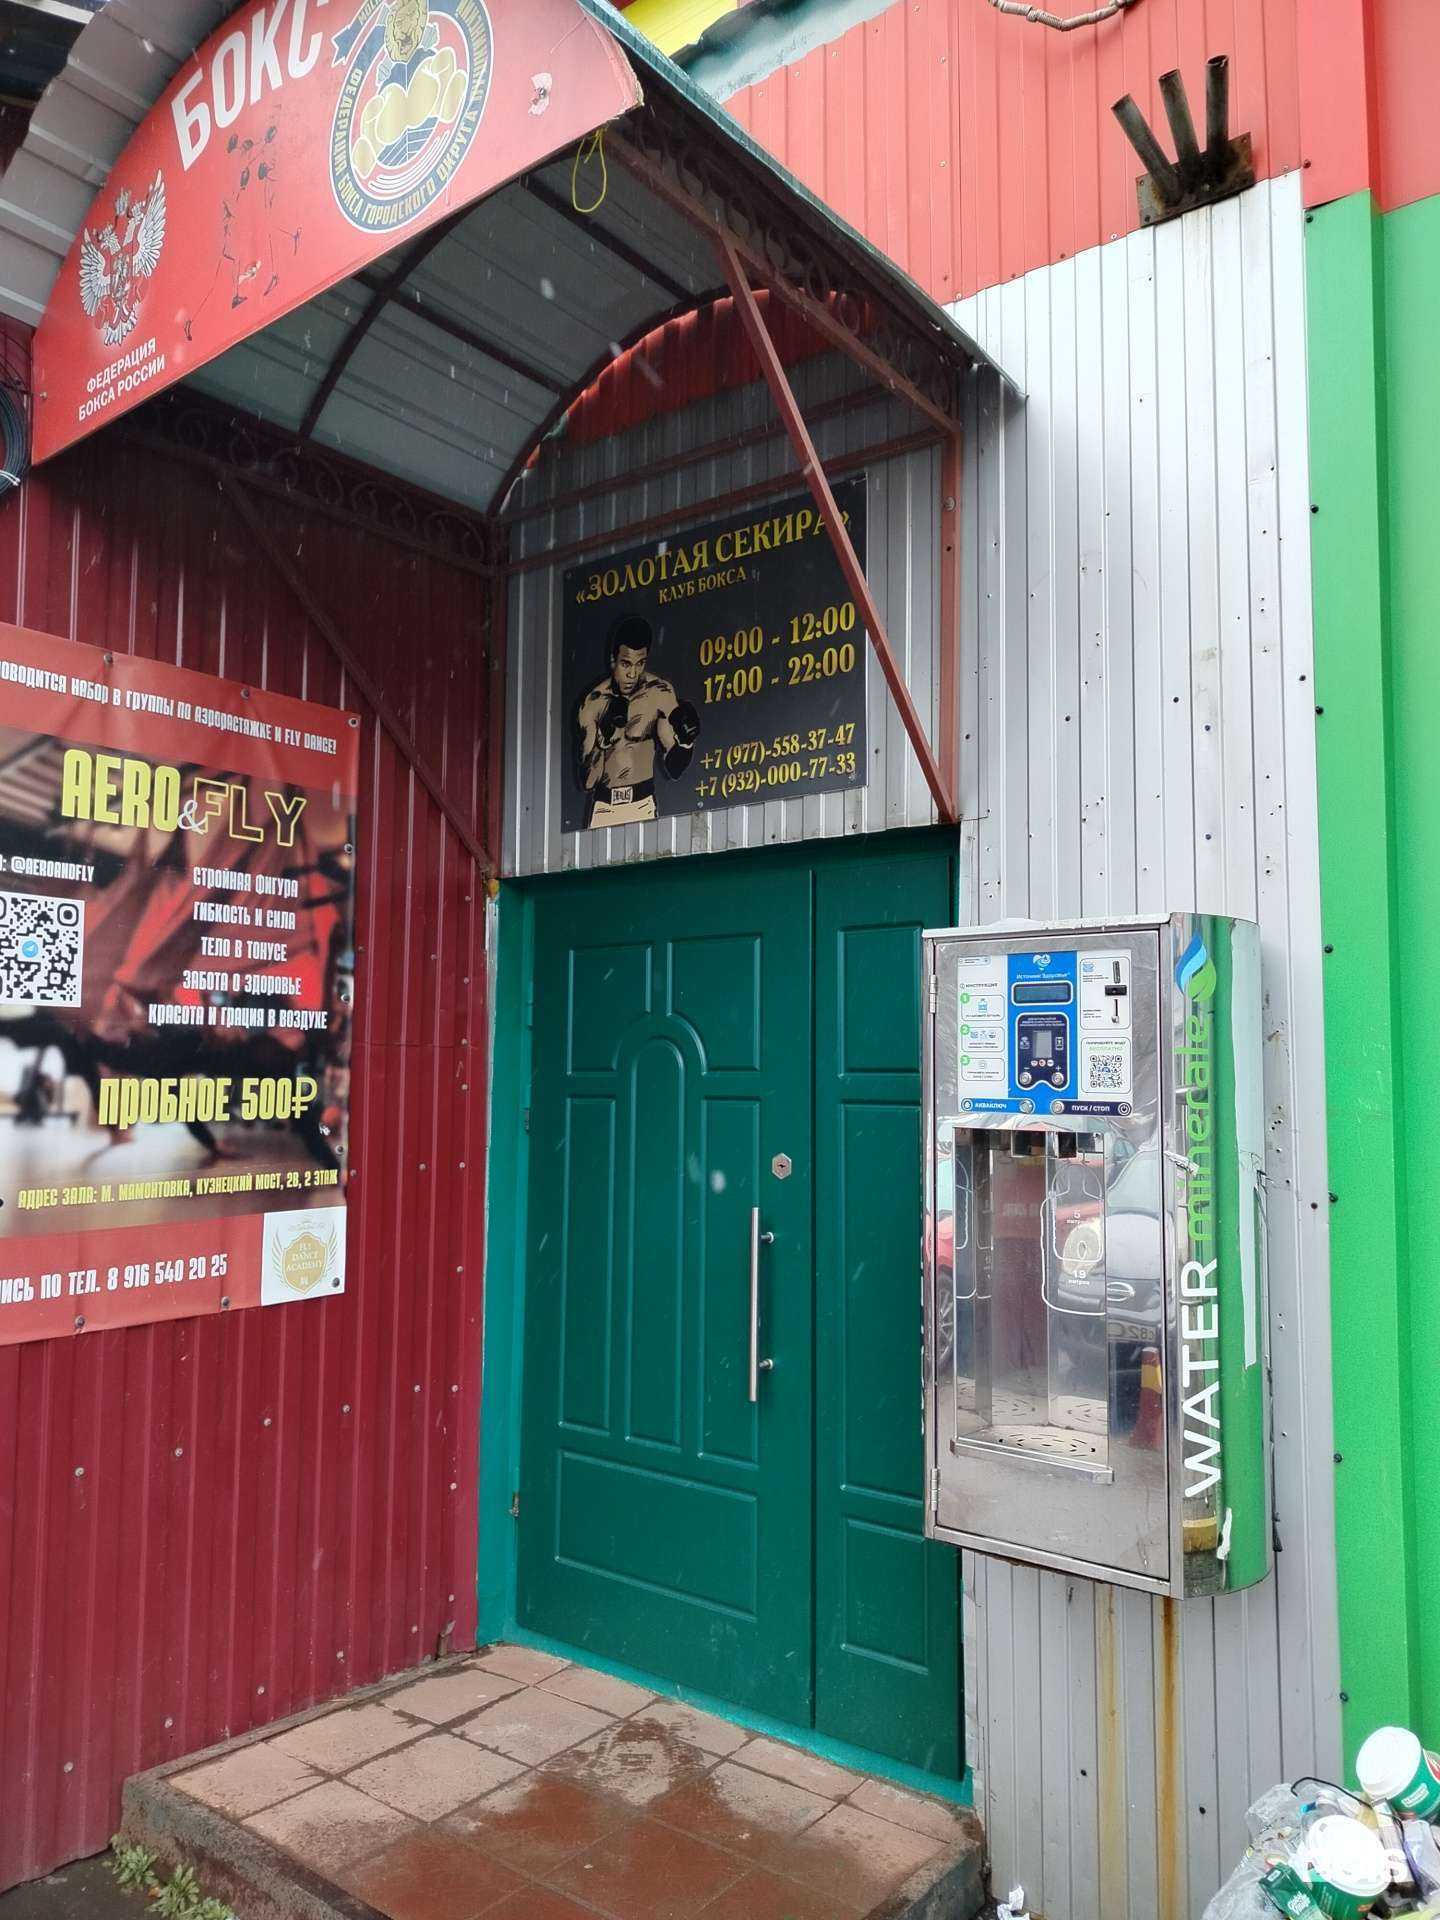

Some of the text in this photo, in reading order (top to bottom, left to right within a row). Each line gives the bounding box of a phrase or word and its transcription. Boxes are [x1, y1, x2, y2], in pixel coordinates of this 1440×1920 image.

[171, 0, 329, 172] БОКС
[334, 68, 363, 176] ФЕДЕРАЦИЯ
[435, 108, 478, 180] ОКРУГА
[338, 172, 364, 217] БОКСА
[362, 176, 436, 225] ГОРОДСКОГО
[78, 353, 166, 422] БОКСА РОССИИ
[86, 337, 156, 393] ФЕДЕРАЦИЯ
[575, 539, 709, 605] «ЗОЛОТАЯ
[658, 565, 748, 605] КЛУБ БОКСА
[699, 625, 764, 667] 09:00
[788, 601, 856, 647] 12:00
[703, 665, 764, 705] 17:00
[787, 643, 856, 687] 22:00
[0, 660, 67, 694] ОВОДИТСЯ
[71, 676, 109, 705] НАБОР
[112, 688, 122, 706] В
[125, 690, 174, 717] ГРУППЫ
[177, 701, 191, 721] ПО
[194, 705, 272, 741] АЭРОРАСТЯЖКЕ
[274, 726, 282, 743] И
[284, 729, 301, 747] FLY
[700, 722, 857, 770] +7 (977)-558-37-47
[61, 749, 182, 833] AERO
[193, 777, 307, 848] FLY
[695, 751, 857, 800] +7 (932)-000-77-33
[11, 855, 95, 883] @AEROANDFLY
[193, 866, 299, 899] СТРОЙНАЯ ФИГУРА
[193, 901, 296, 930] ГИБКОСТЬ И СИЛА
[200, 936, 288, 962] ТЕЛО В ТОНУСЕ
[183, 970, 302, 996] ЗАБОТА О ЗДОРОВЬЕ
[149, 1003, 328, 1031] КРАСОТА И ГРАЦИЯ В ВОЗДУХЕ
[98, 1076, 319, 1130] ПРОБНОЕ 500₽
[1071, 1102, 1088, 1111] ПУСК
[1093, 1103, 1110, 1112] СТОП
[18, 1169, 338, 1210] АДРЕС ЗАЛА: М. МАМОНТОВКА, КУЗНЕЦКИЙ МОСТ, 2В, 2 ЭТАЖ
[40, 1273, 62, 1300] ПО
[68, 1269, 101, 1296] ТЕЛ.
[107, 1267, 119, 1291] 8
[124, 1263, 150, 1289] 916
[154, 1259, 184, 1285] 540
[189, 1256, 206, 1281] 20
[211, 1253, 228, 1278] 25
[1072, 1269, 1087, 1279] 19
[1175, 1013, 1221, 1497] WATER minerale
